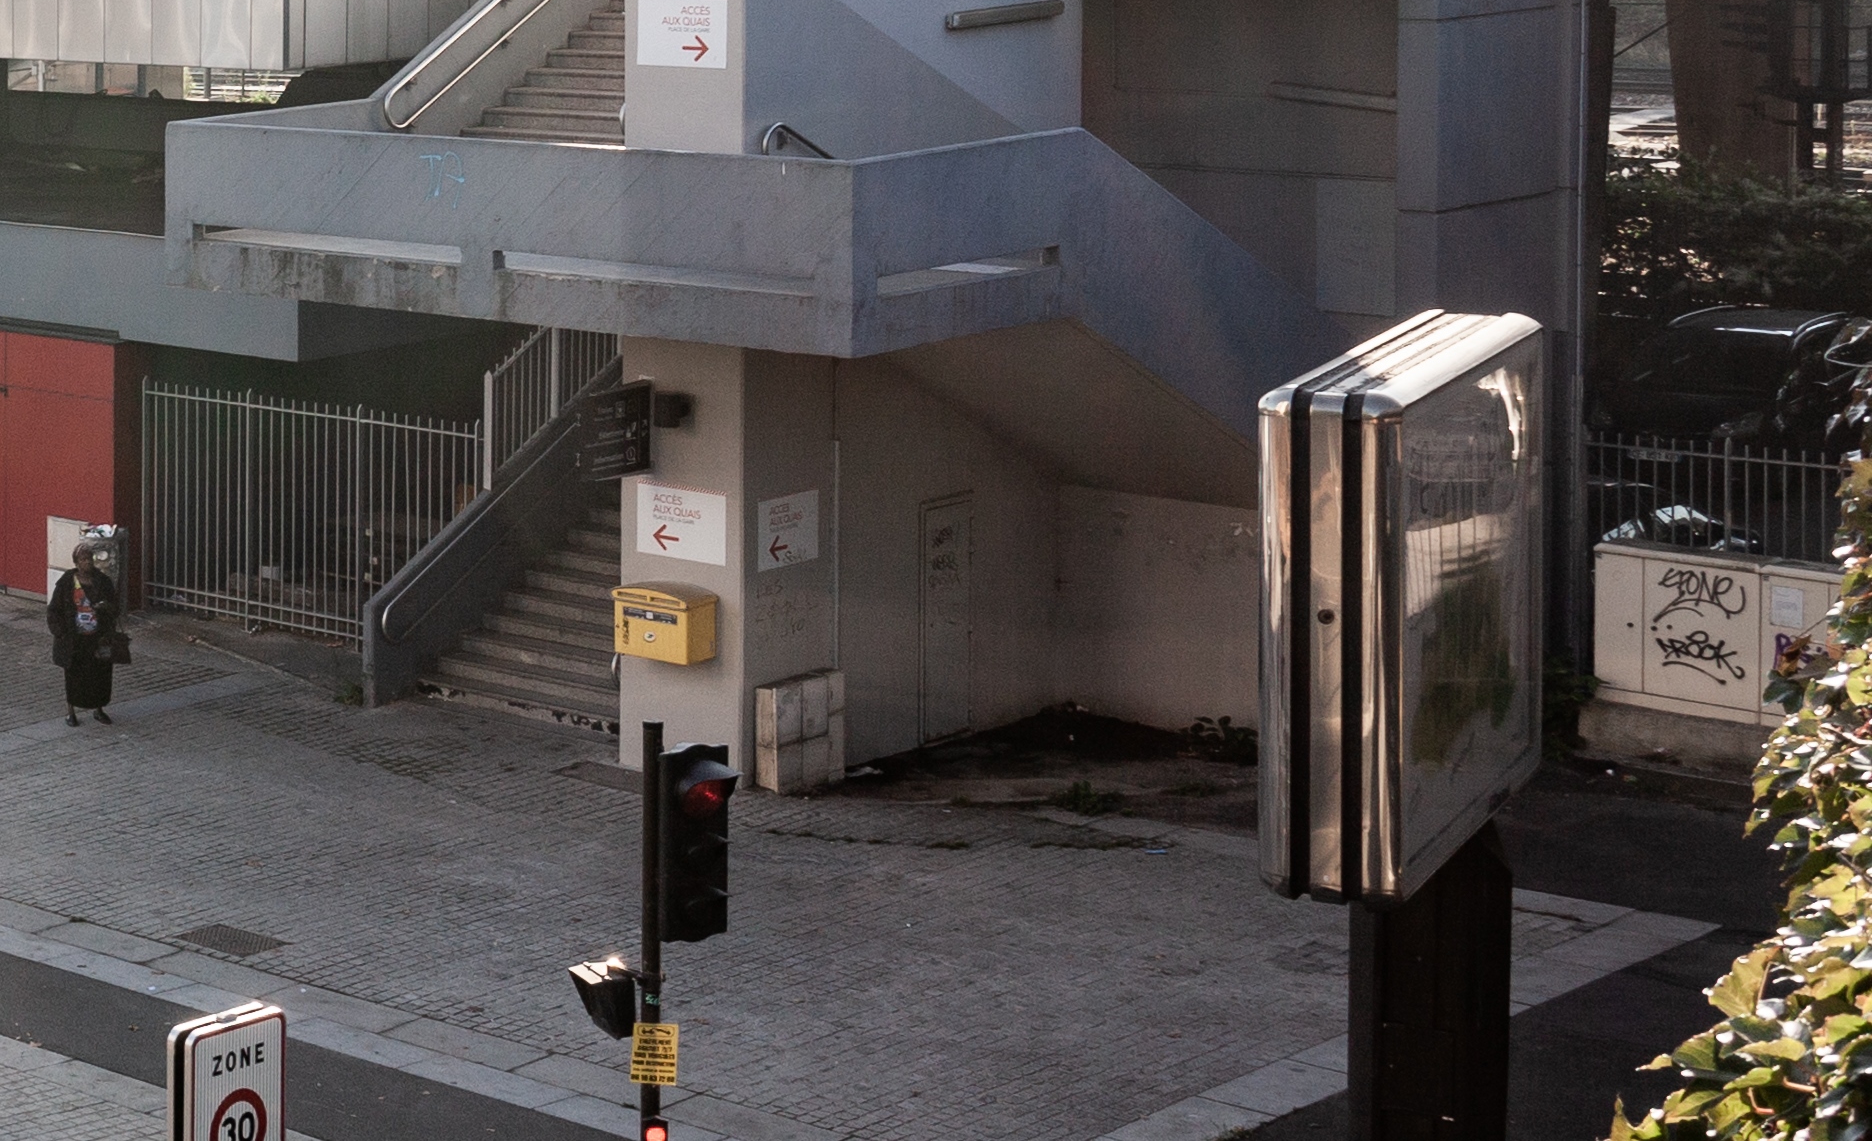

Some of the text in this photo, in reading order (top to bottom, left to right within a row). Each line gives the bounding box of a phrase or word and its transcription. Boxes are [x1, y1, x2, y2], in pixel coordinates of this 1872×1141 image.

[680, 5, 710, 16] ACCÈS
[661, 16, 710, 27] AUX QUAIS
[653, 493, 683, 506] ACCÈS
[653, 504, 702, 520] AUX QUAIS
[212, 1042, 264, 1077] ZONE
[221, 1111, 255, 1141] 30
